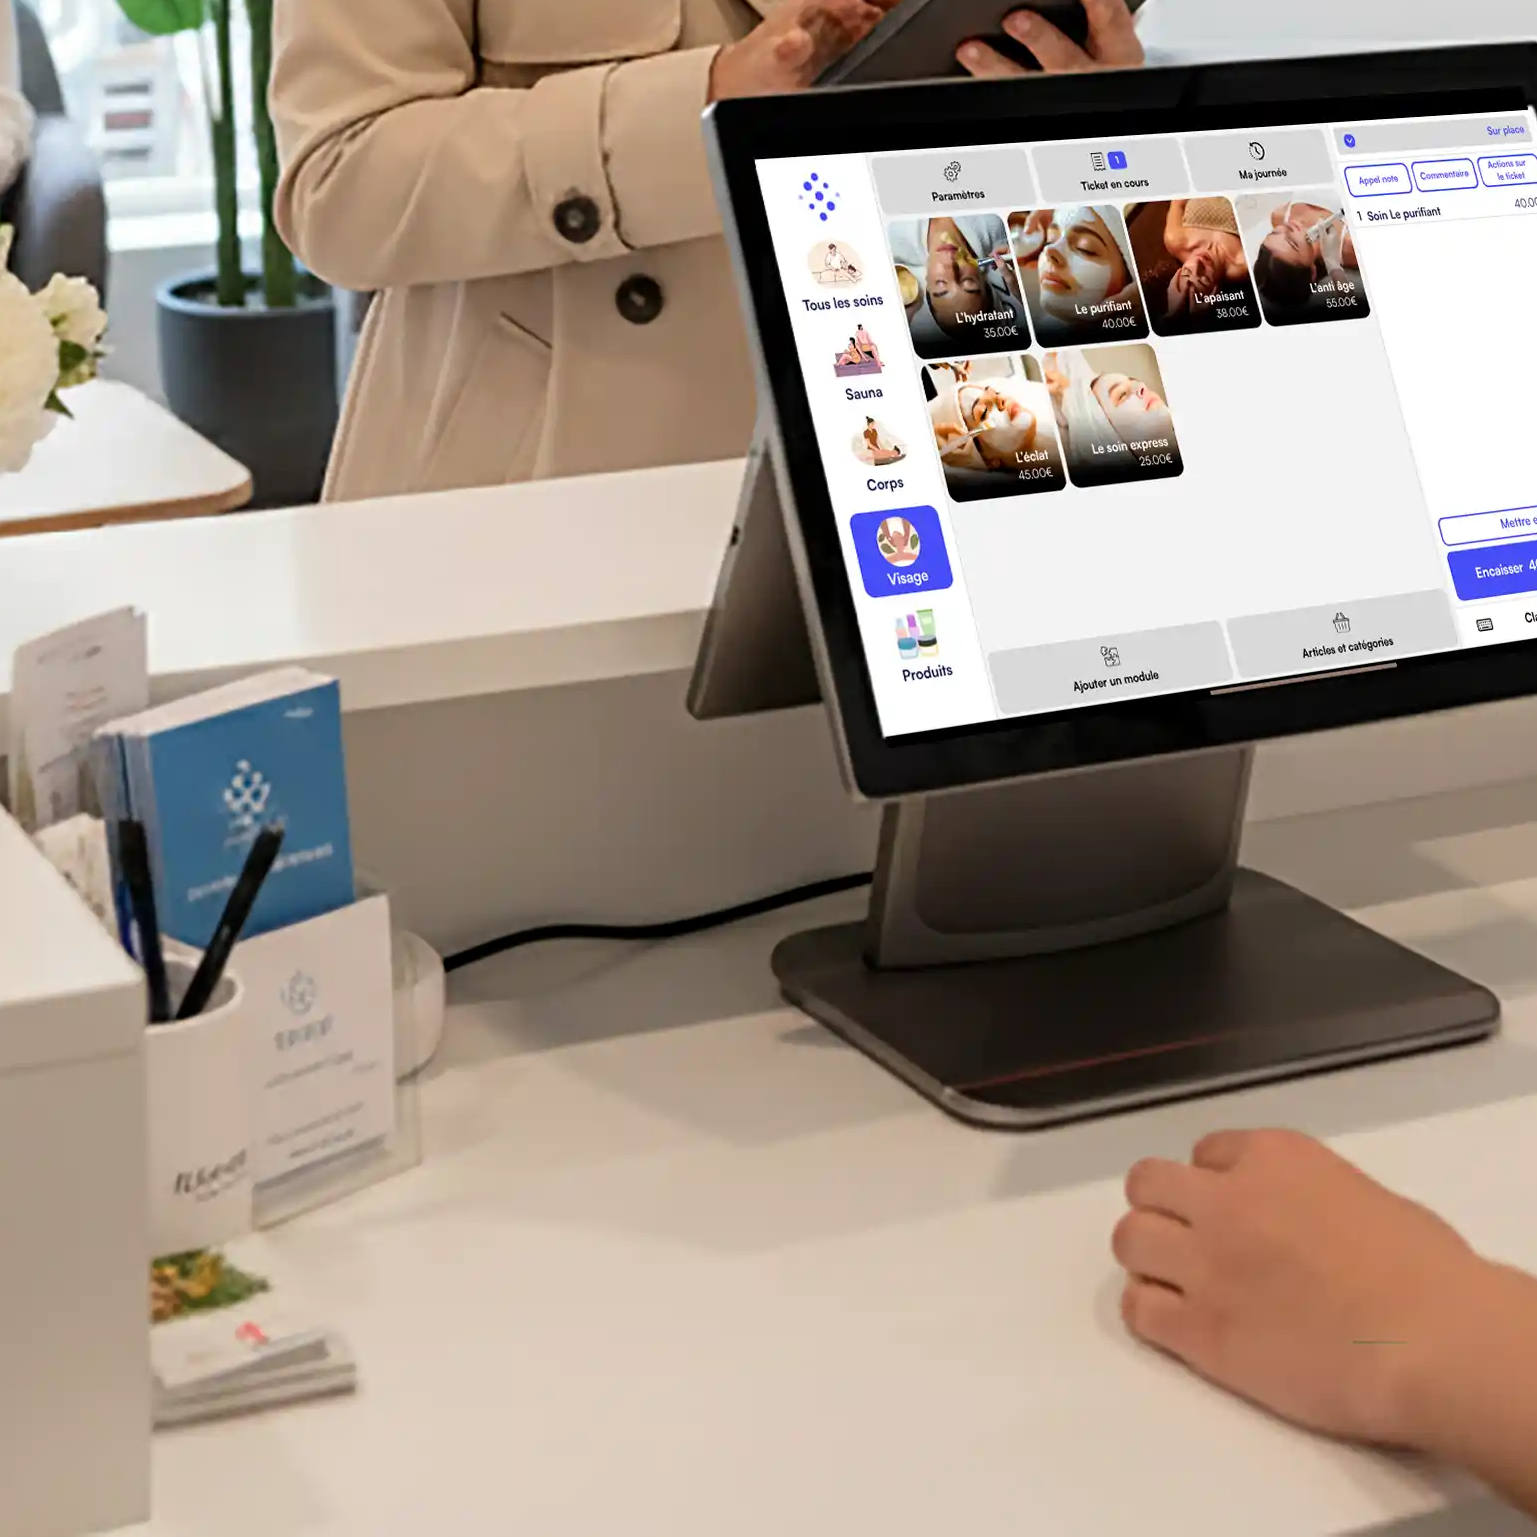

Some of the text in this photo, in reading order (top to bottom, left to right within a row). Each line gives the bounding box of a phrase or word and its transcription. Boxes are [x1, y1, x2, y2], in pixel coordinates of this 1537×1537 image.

[1487, 126, 1525, 136] Sur place
[1115, 156, 1120, 164] 1
[1488, 160, 1513, 169] Actions
[1239, 168, 1287, 181] Ma journée
[1359, 175, 1380, 185] Appel
[1420, 170, 1469, 180] Commentaire
[1506, 172, 1525, 180] ticket
[1081, 178, 1149, 191] Ticket en cours
[932, 190, 985, 202] Paramètres
[1357, 207, 1441, 221] 1 Soin Le purifiant
[1338, 280, 1355, 293] âge
[802, 295, 883, 311] Tous les soins
[1195, 291, 1244, 307] L'apaisant
[1326, 297, 1357, 308] 55.00€
[1075, 300, 1131, 315] Le purifiant
[1216, 306, 1249, 318] 38.00€
[956, 310, 1013, 325] L'hydratant
[1102, 317, 1136, 329] 40.00€
[984, 326, 1018, 338] 35.00€
[845, 387, 883, 401] Sauna
[1091, 438, 1168, 454] Le soin express
[1015, 450, 1049, 464] L'éclat
[1139, 454, 1173, 467] 25.00€
[1019, 467, 1053, 480] 45.00€
[867, 477, 904, 492] Corps
[1501, 516, 1530, 529] Mettre
[1475, 563, 1523, 579] Encaisser
[888, 571, 929, 586] Visage
[1302, 637, 1394, 658] Articles et catégories
[902, 665, 953, 681] Produits
[1074, 670, 1159, 693] Ajouter un module
